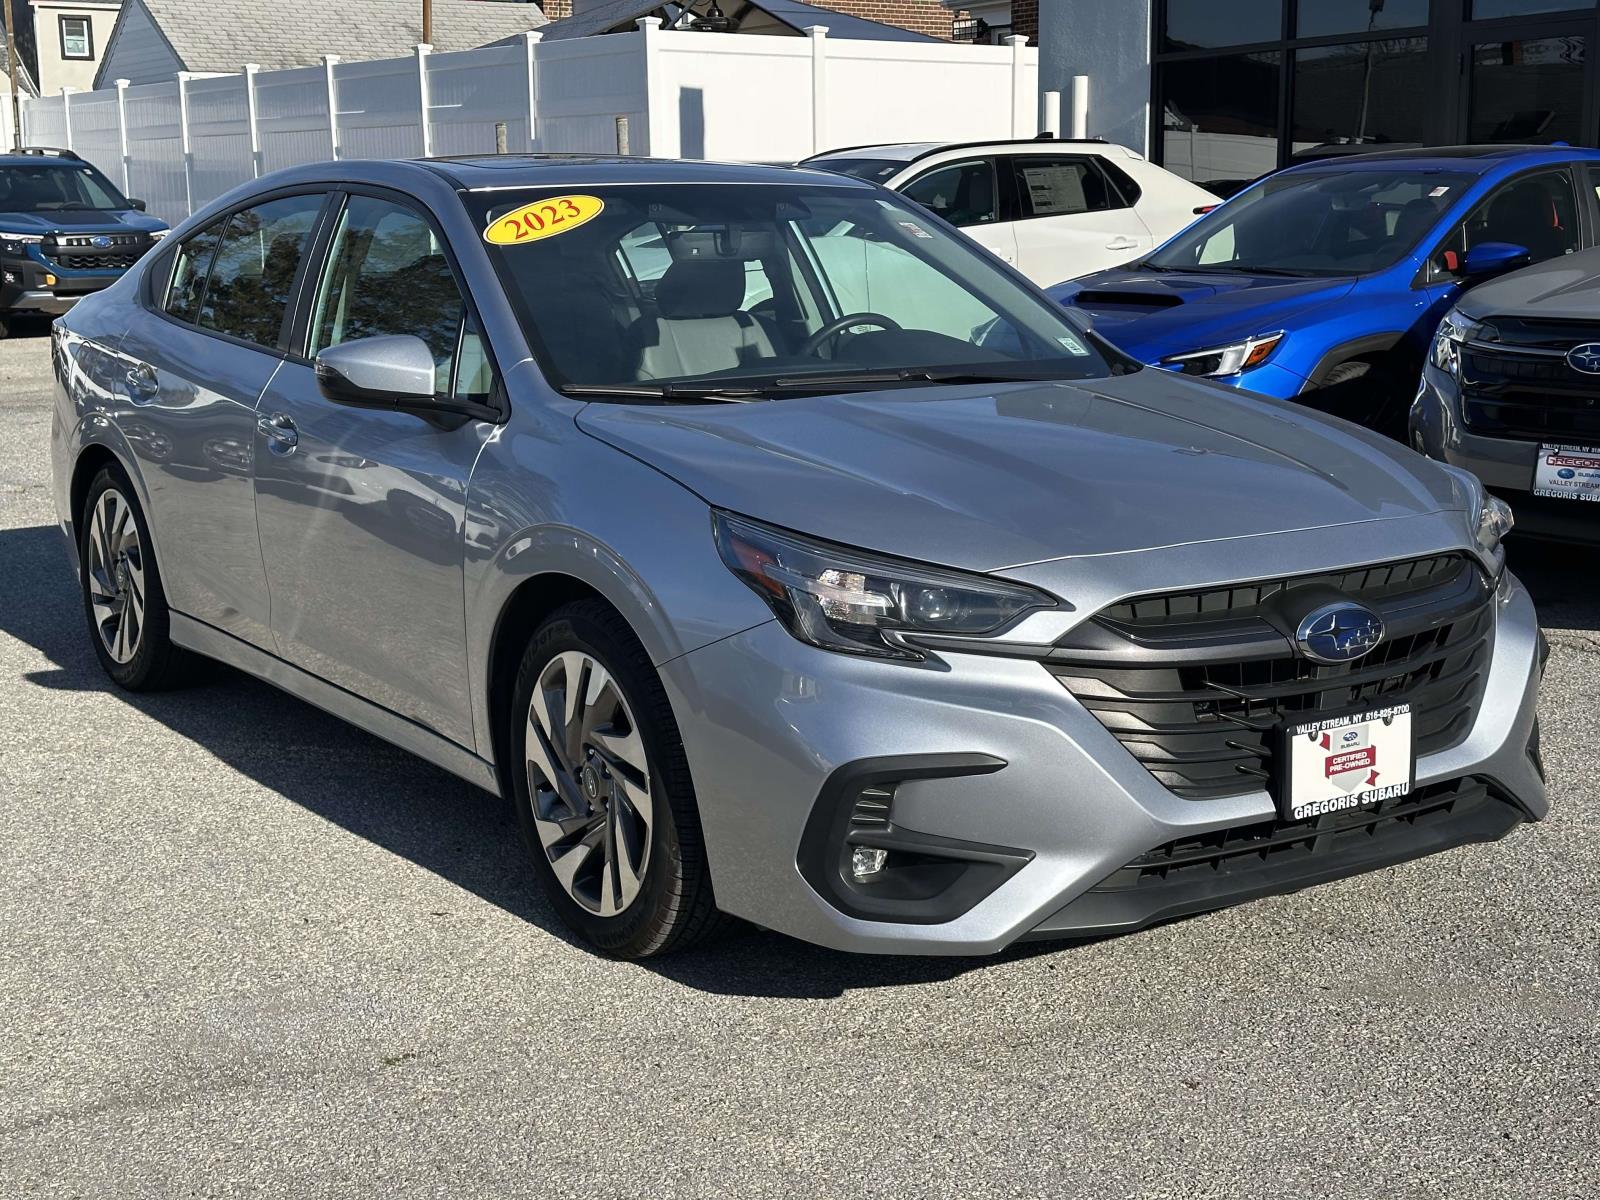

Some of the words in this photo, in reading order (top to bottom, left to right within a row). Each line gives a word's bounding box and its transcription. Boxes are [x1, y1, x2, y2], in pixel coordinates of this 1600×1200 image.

[505, 199, 581, 240] 2023
[1548, 479, 1573, 487] VALLEY
[1574, 481, 1600, 489] STREAM
[1533, 489, 1577, 499] GREGORIS
[1296, 722, 1321, 734] VALLEY
[1353, 714, 1362, 723] NY
[1330, 758, 1370, 772] PRE-OWNED
[1333, 752, 1367, 764] CERTIFIED
[1294, 796, 1358, 819] GREGORIS
[1362, 783, 1409, 804] SUBARU
